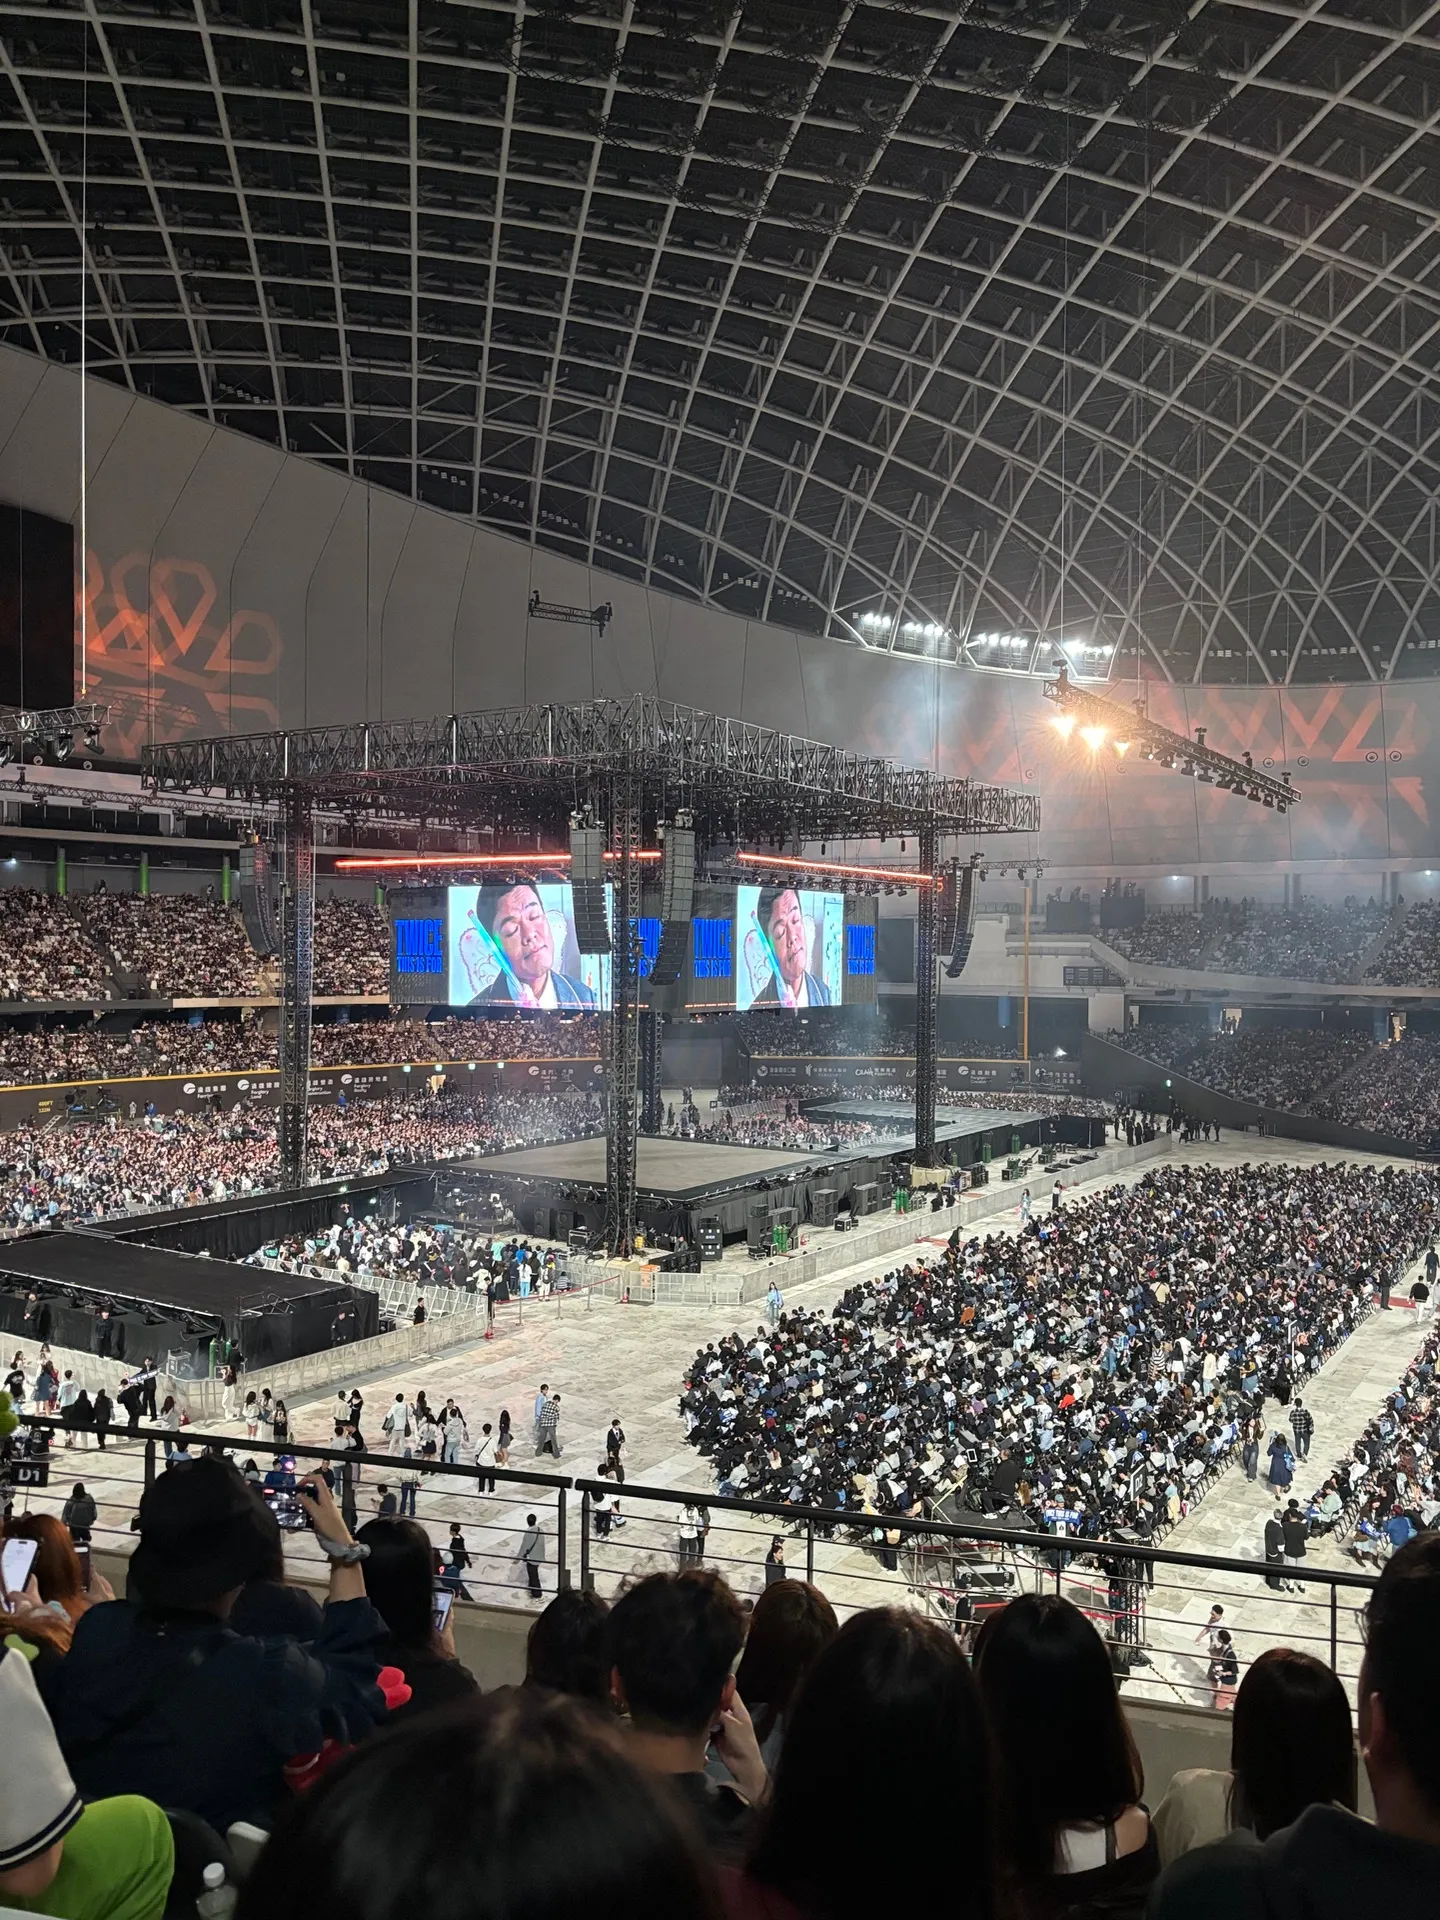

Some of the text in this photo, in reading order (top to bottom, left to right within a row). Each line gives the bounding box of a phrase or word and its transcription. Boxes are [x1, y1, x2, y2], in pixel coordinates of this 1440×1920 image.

[395, 919, 443, 956] TWICE
[693, 918, 732, 958] TWICE
[846, 925, 875, 959] TWICE
[397, 956, 443, 972] THIS IS FOR
[18, 1468, 40, 1482] D1
[1135, 1473, 1143, 1492] D2
